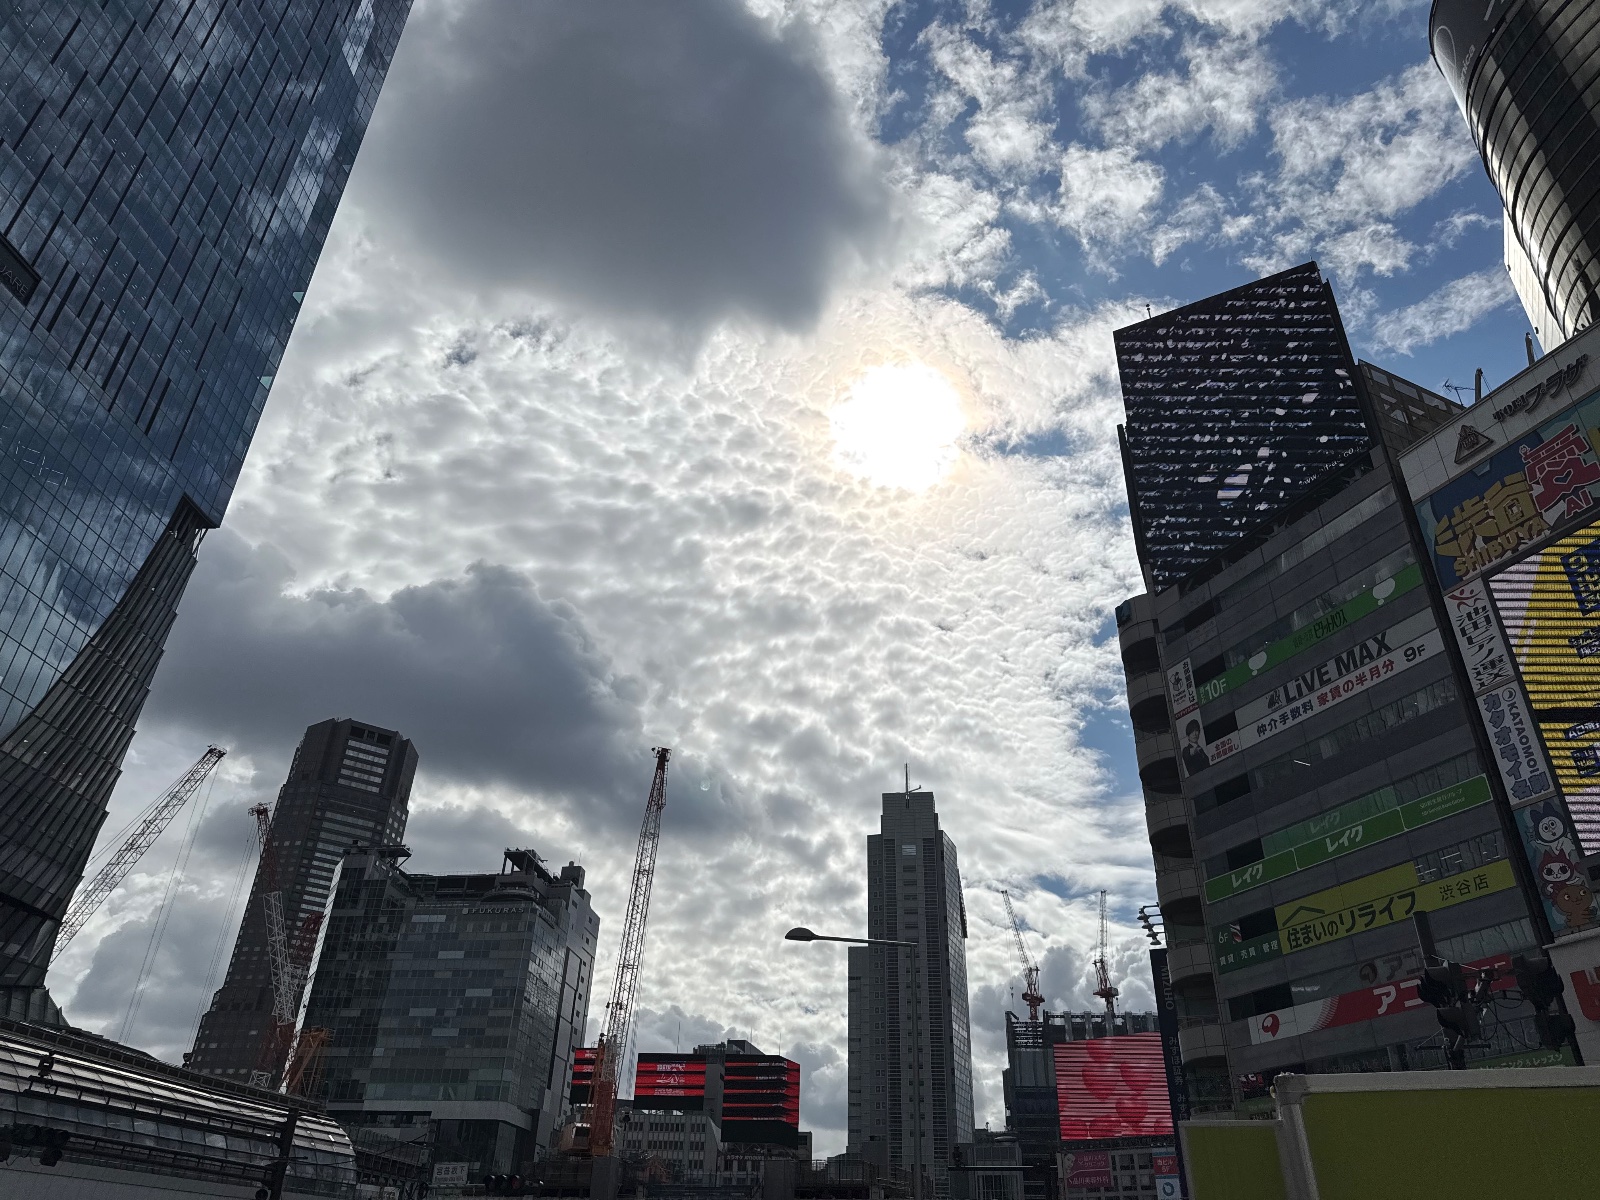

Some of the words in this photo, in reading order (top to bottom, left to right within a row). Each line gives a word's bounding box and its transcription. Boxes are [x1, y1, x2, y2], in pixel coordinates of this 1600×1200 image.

[1435, 471, 1537, 556] 渋谷
[1454, 516, 1549, 577] SHIBUYA
[1565, 488, 1593, 519] AI
[1335, 632, 1392, 678] MAX
[1456, 605, 1510, 690] 池田ピアノ運送
[1205, 678, 1227, 700] 10F
[1256, 699, 1314, 737] 仲介手数料
[1317, 659, 1395, 706] 家賃の半月分
[1403, 644, 1426, 663] 9F
[1211, 743, 1239, 762] お部屋探し
[1310, 811, 1340, 834] レイク
[1325, 825, 1363, 853] レイク
[1231, 863, 1263, 888] レイク
[1287, 891, 1416, 950] 住まいのリライフ
[1439, 873, 1489, 901] 渋谷店
[1218, 931, 1228, 944] 6F
[1240, 946, 1256, 959] 売買
[1262, 939, 1279, 953] 管理
[1160, 965, 1175, 1010] MIZUHO
[1168, 1036, 1183, 1085] みずほ証券
